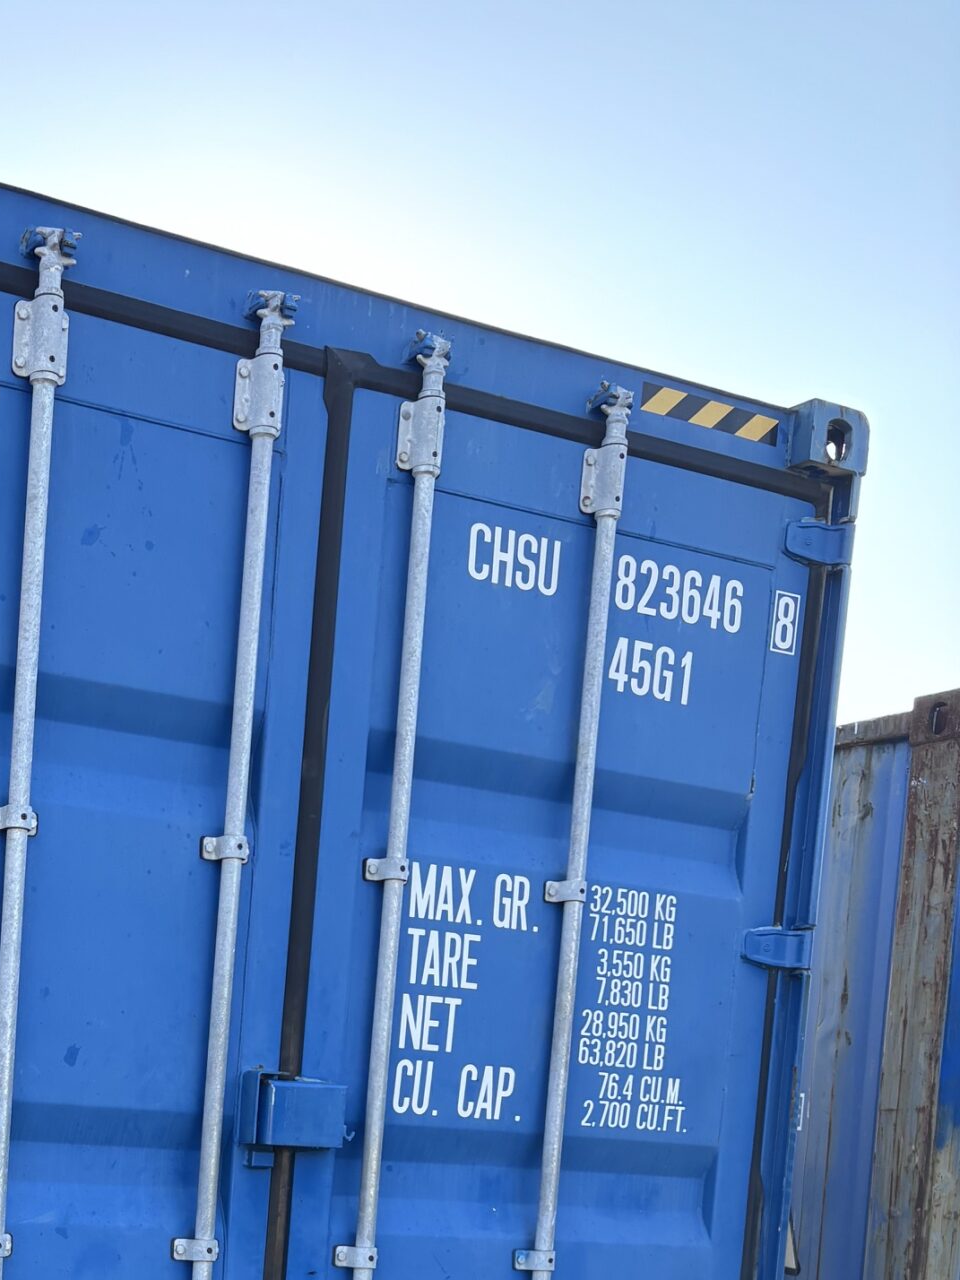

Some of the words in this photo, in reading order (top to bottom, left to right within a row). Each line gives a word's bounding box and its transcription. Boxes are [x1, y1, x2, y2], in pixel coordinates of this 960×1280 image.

[467, 522, 561, 596] CHSU
[614, 555, 744, 634] 823646
[774, 596, 795, 650] 8
[608, 636, 693, 706] 45G1
[408, 861, 483, 926] MAX.
[492, 873, 539, 933] GR.
[589, 885, 650, 918] 32,500
[654, 893, 677, 922] KG
[407, 927, 482, 990] TARE
[596, 949, 644, 979] 3,550
[649, 955, 672, 983] KG
[589, 913, 647, 947] 71,650
[651, 920, 675, 950] LB
[398, 993, 462, 1053] NET
[580, 1009, 640, 1040] 28,950
[645, 1015, 668, 1043] KG
[596, 977, 642, 1008] 7,830
[647, 982, 669, 1011] LB
[577, 1039, 638, 1069] 63,820
[642, 1043, 665, 1072] LB
[392, 1058, 438, 1116] CU.
[456, 1063, 521, 1122] CAP.
[597, 1072, 634, 1100] 76.4
[639, 1075, 683, 1105] CU.M.
[580, 1100, 631, 1129] 2,700
[635, 1102, 688, 1133] CU.FT.
